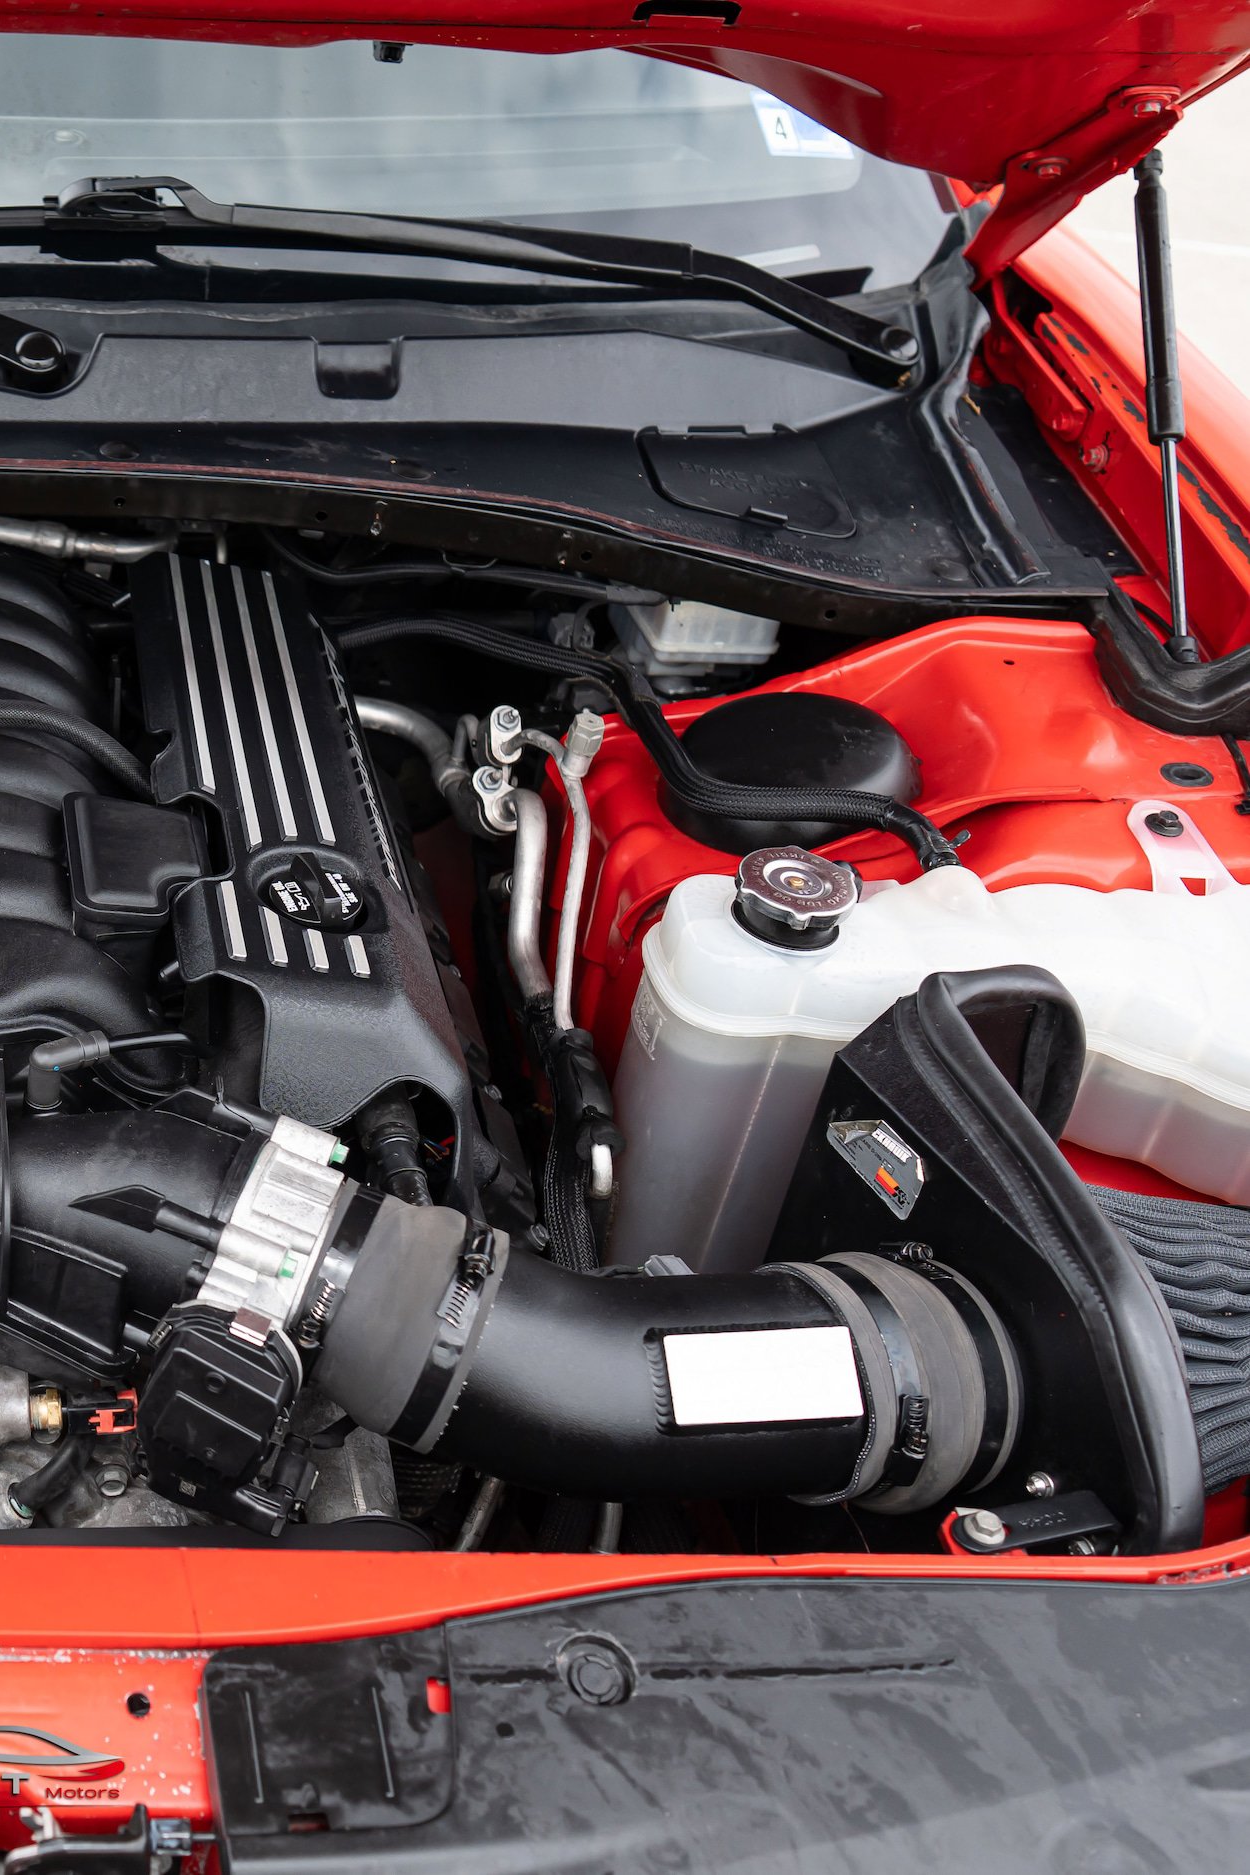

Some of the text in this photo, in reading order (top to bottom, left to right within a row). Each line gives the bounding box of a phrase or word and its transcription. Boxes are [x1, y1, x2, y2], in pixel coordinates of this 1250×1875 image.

[775, 116, 787, 139] 4
[679, 460, 749, 482] BRAKE
[271, 880, 299, 913] ENGINE OIL
